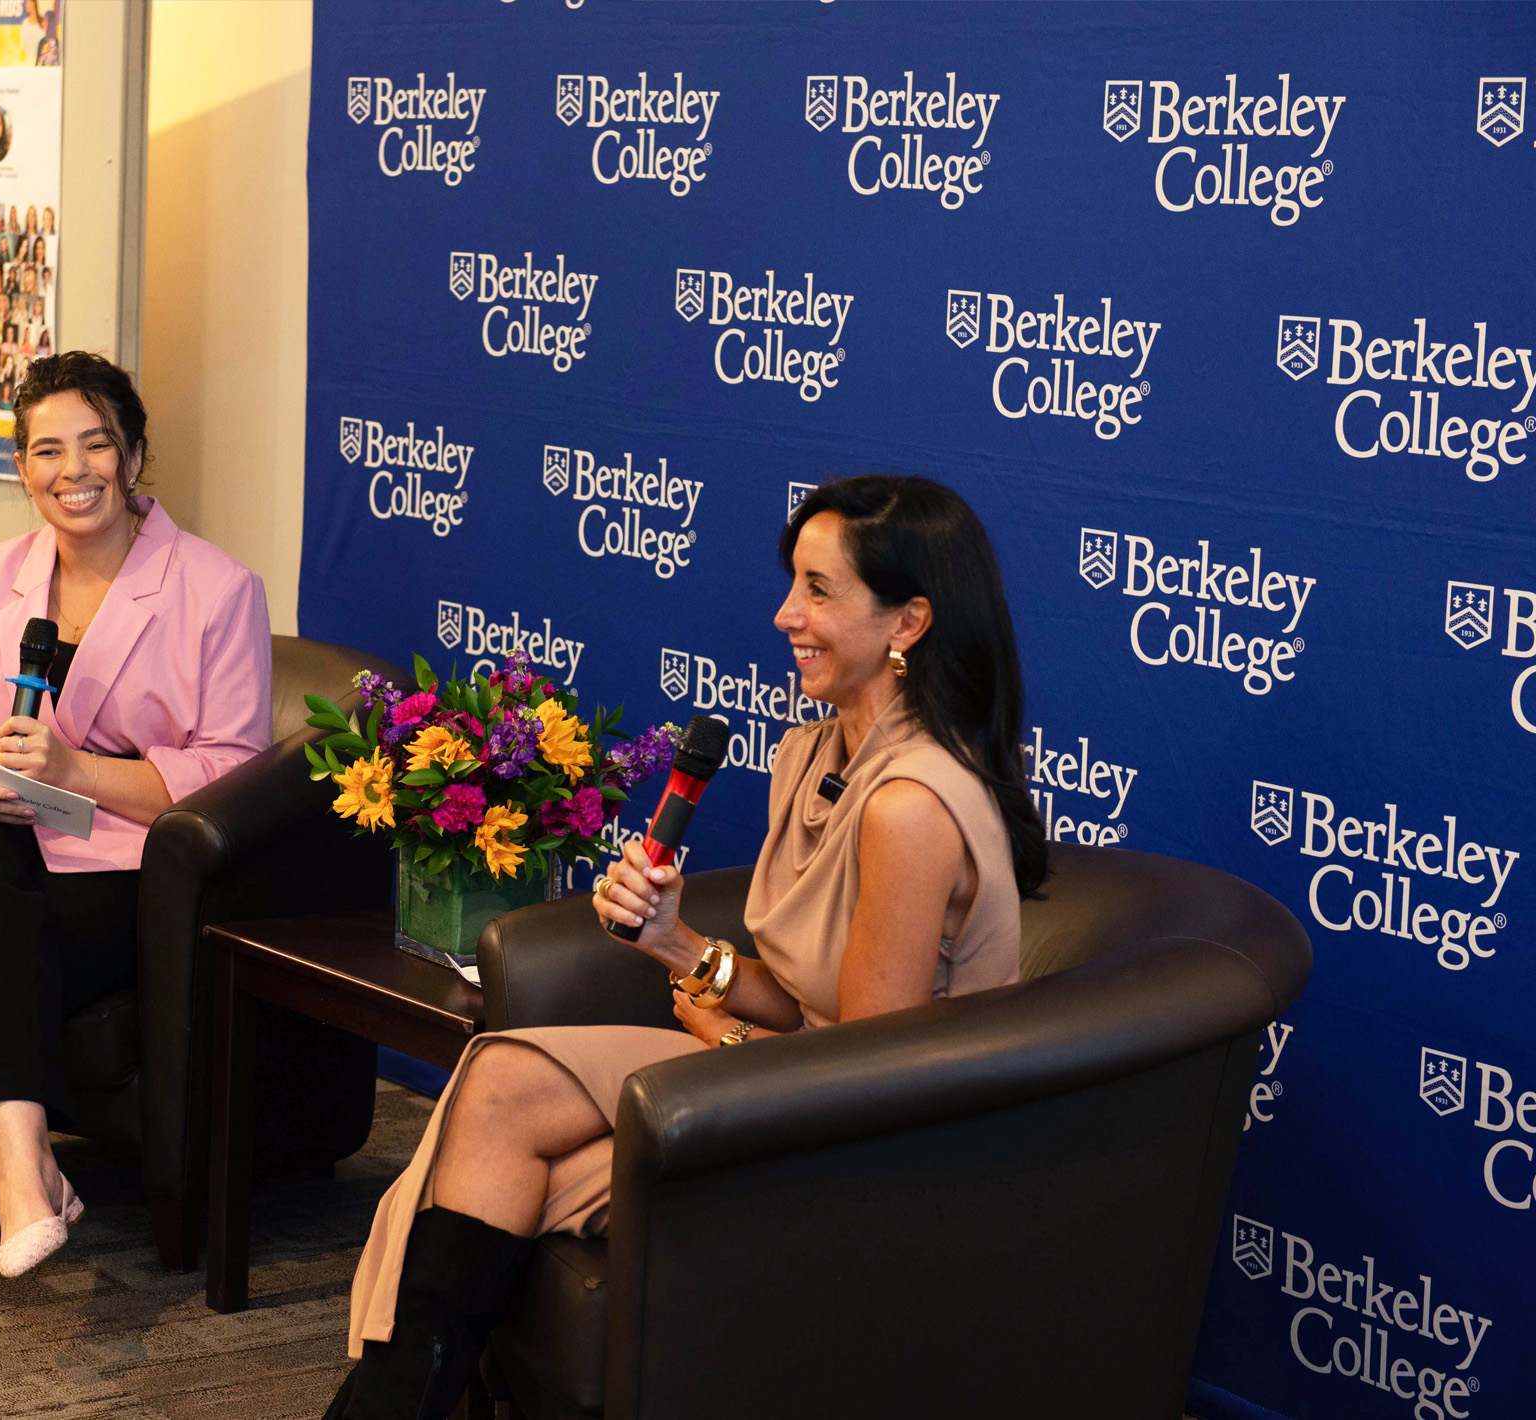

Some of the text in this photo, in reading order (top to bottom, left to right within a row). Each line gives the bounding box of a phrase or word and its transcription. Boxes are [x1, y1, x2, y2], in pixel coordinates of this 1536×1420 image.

[374, 72, 486, 134] Berkeley
[587, 72, 720, 141] Berkeley
[842, 71, 1000, 148] Berkeley
[1148, 73, 1346, 157] Berkeley
[478, 252, 598, 321] Berkeley
[709, 270, 854, 345] Berkeley
[986, 294, 1161, 378] Berkeley
[1327, 318, 1536, 412] Berkeley
[365, 421, 474, 489] Berkeley
[573, 450, 703, 527] Berkeley
[1123, 535, 1316, 633] Berkeley
[465, 606, 584, 686] Berkeley
[1300, 792, 1519, 907] Berkeley
[1282, 1232, 1492, 1369] Berkeley
